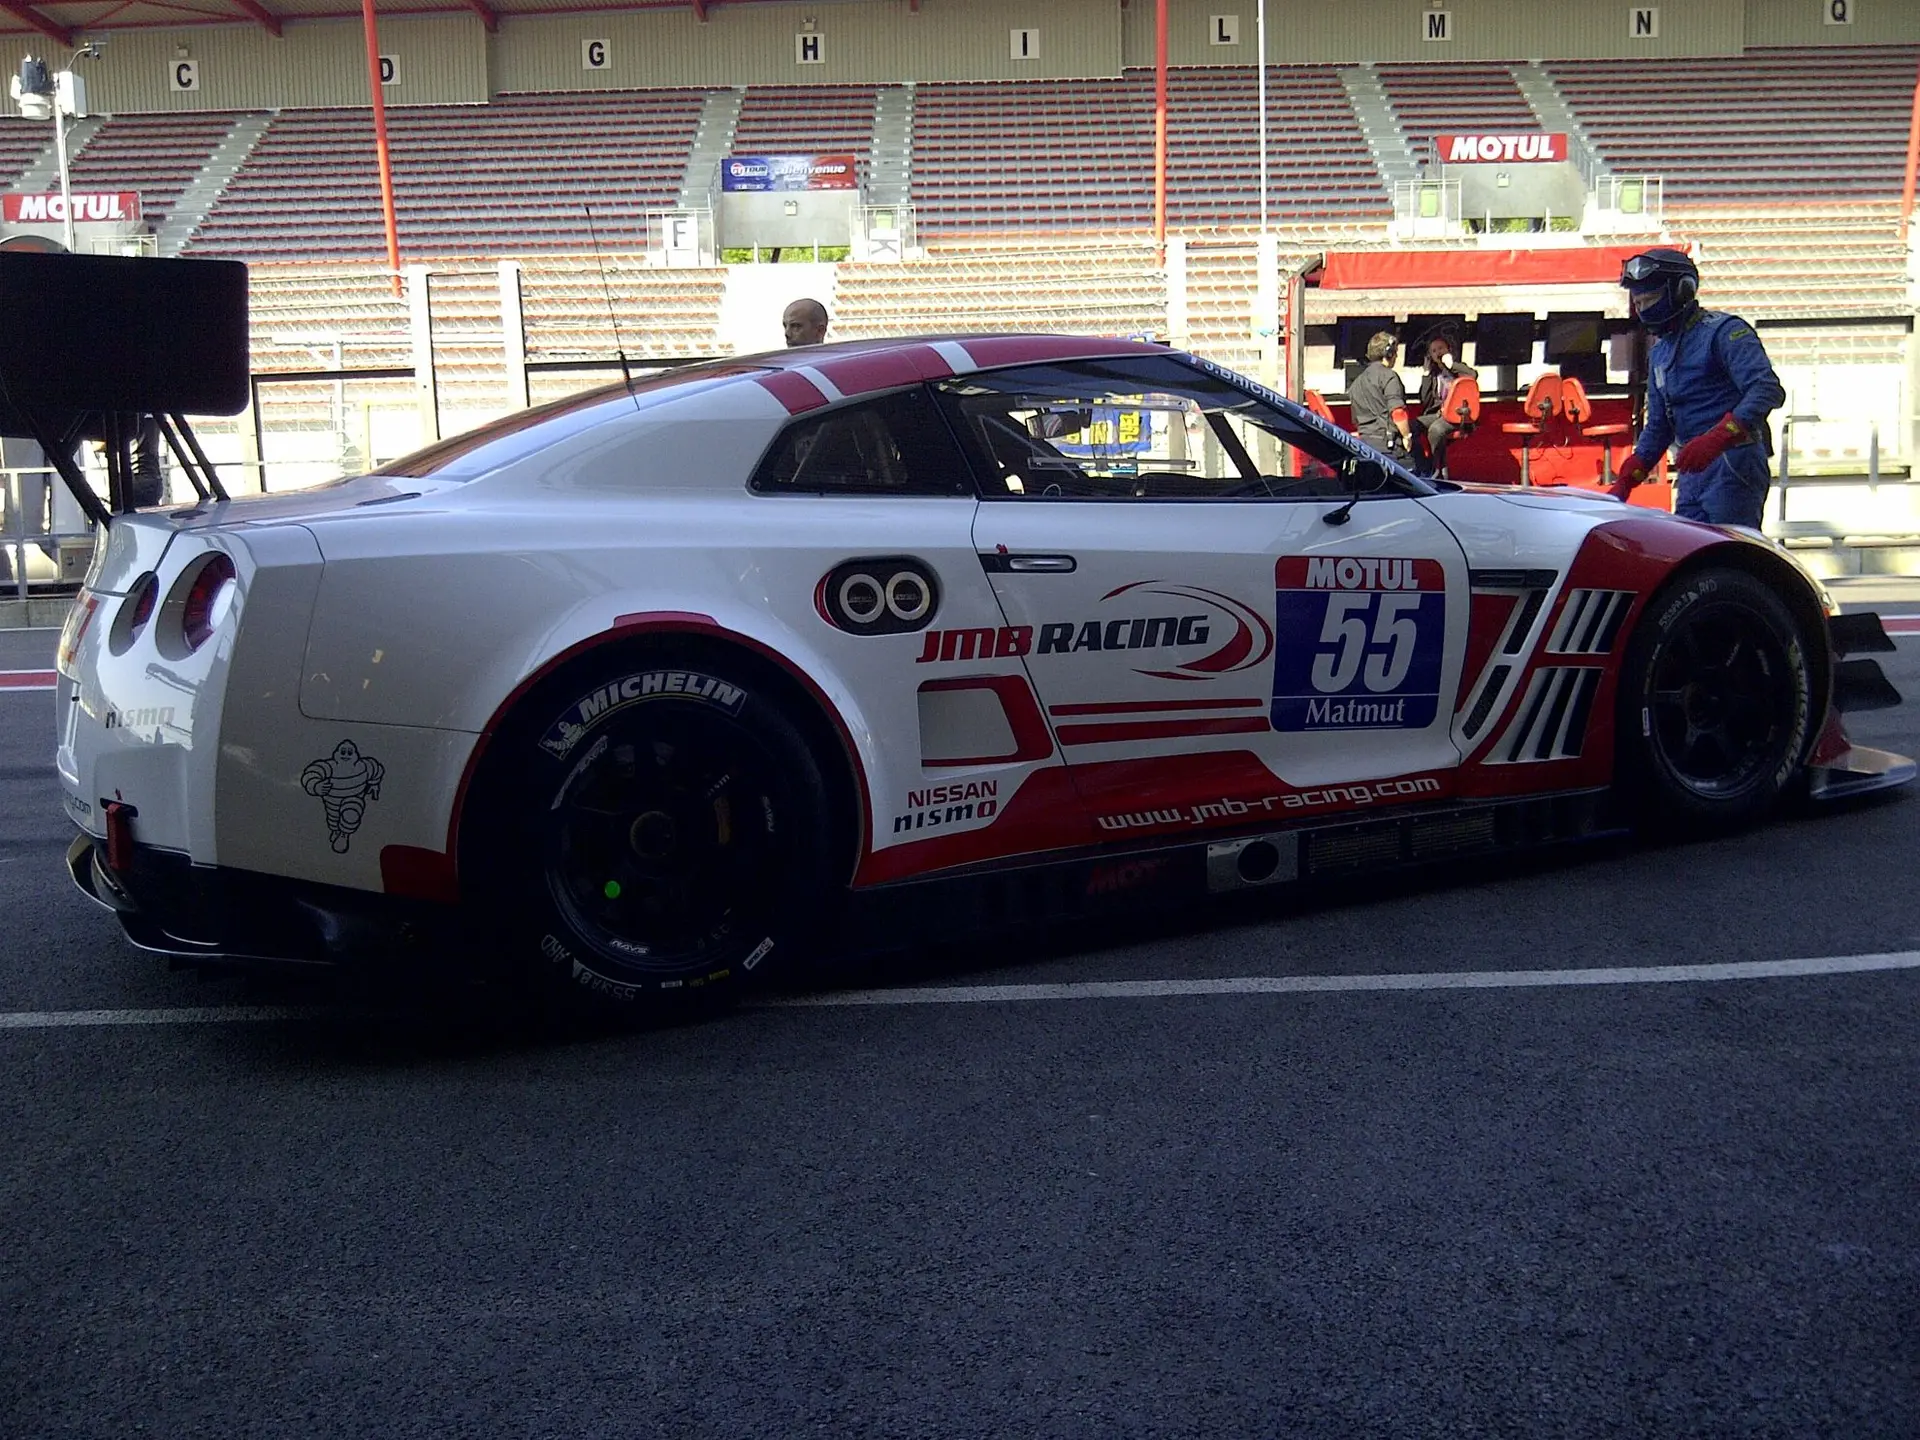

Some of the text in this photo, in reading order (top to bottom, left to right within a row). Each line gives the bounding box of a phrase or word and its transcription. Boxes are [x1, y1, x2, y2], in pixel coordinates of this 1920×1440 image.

[1636, 10, 1652, 35] N
[1830, 0, 1847, 24] Q
[1218, 18, 1231, 42] L
[1428, 14, 1446, 38] M
[588, 42, 605, 66] G
[802, 36, 819, 61] H
[1022, 31, 1029, 57] I
[176, 65, 192, 88] C
[379, 57, 394, 83] D
[1448, 135, 1555, 162] MOTUL
[19, 195, 124, 221] MOTUL
[674, 220, 688, 248] F
[871, 239, 897, 255] K
[1306, 557, 1419, 590] MOTUL
[915, 615, 1210, 663] JMB RACING
[1311, 592, 1422, 693] 55
[578, 672, 744, 723] MICHELIN
[105, 706, 175, 729] nismo
[1305, 698, 1406, 724] Matmut
[907, 780, 998, 809] NISSAN
[1098, 775, 1441, 831] www.jmb-racing.com
[893, 799, 998, 834] nismo
